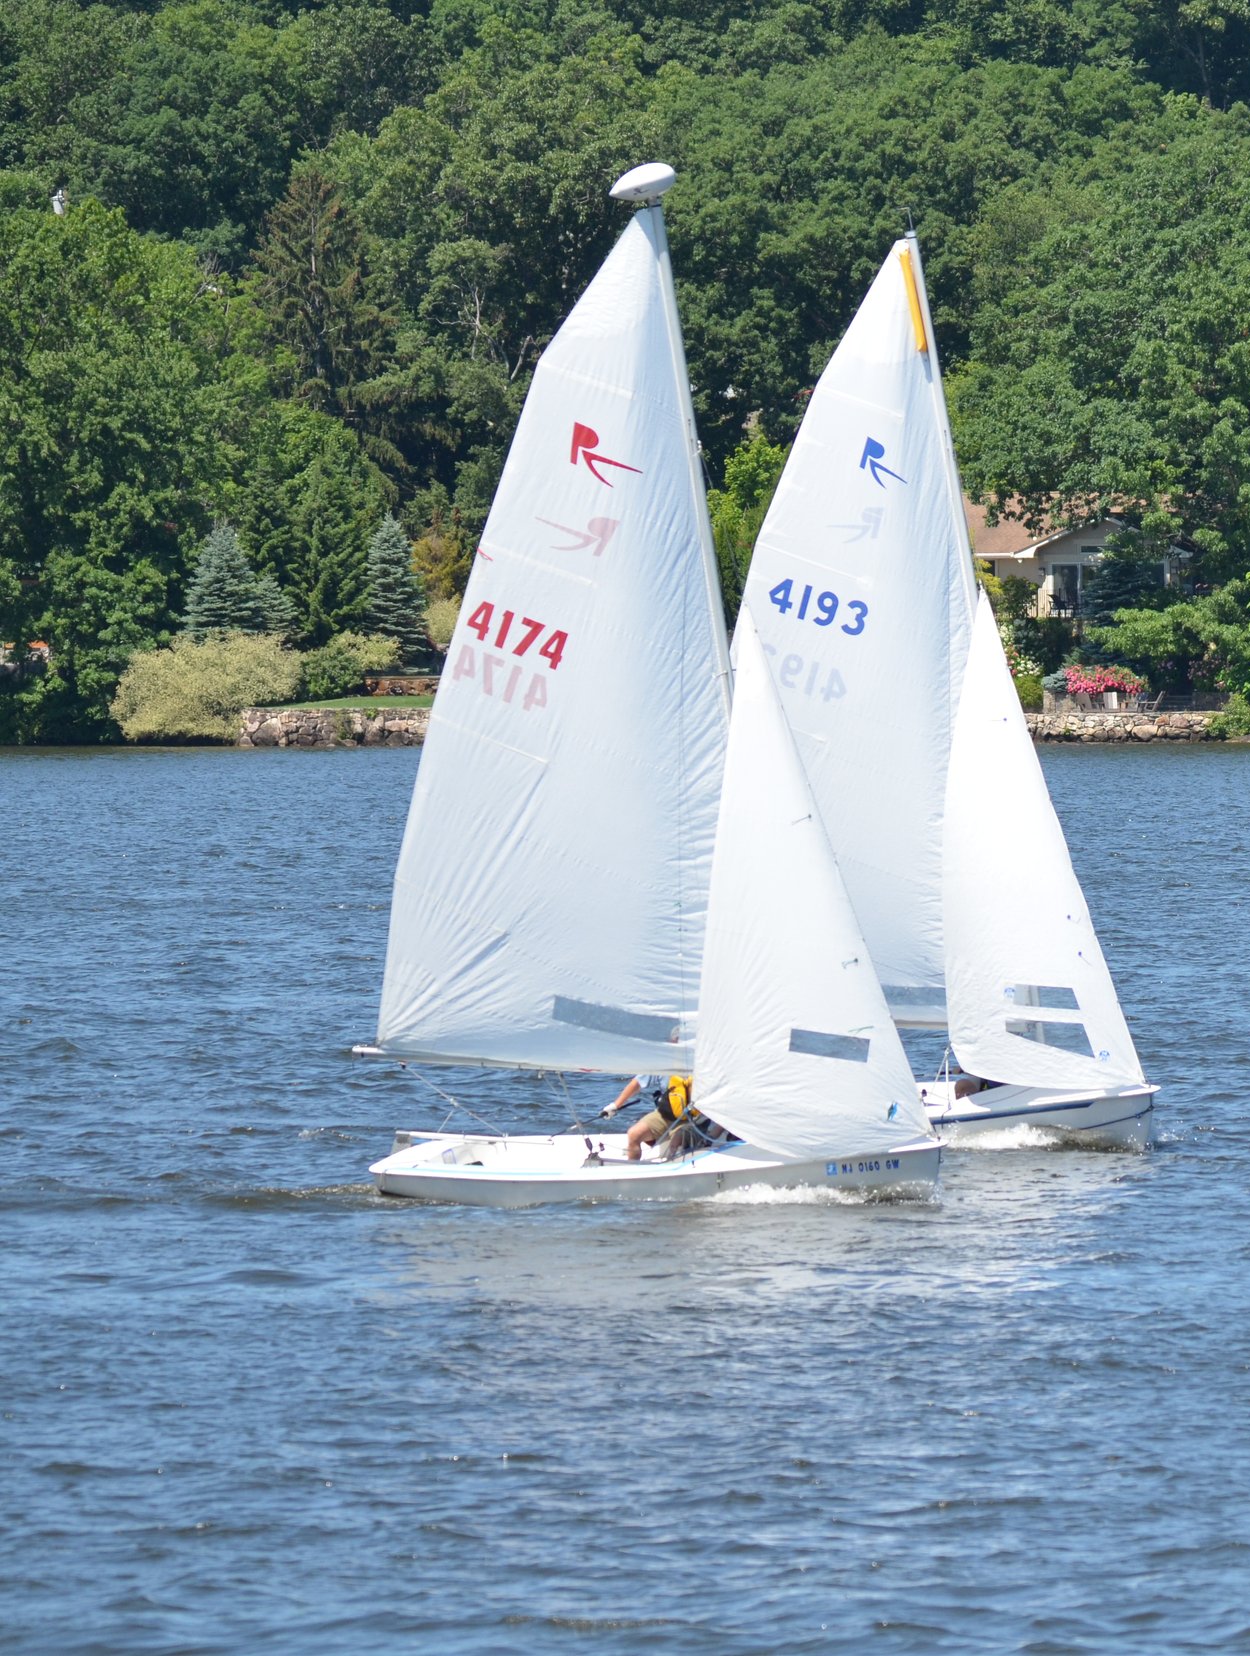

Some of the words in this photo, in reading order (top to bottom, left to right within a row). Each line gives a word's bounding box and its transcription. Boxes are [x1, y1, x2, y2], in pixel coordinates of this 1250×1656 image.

[466, 600, 569, 671] 4174
[769, 578, 869, 636] 4193
[858, 1160, 880, 1172] 0160
[885, 1159, 900, 1169] GW
